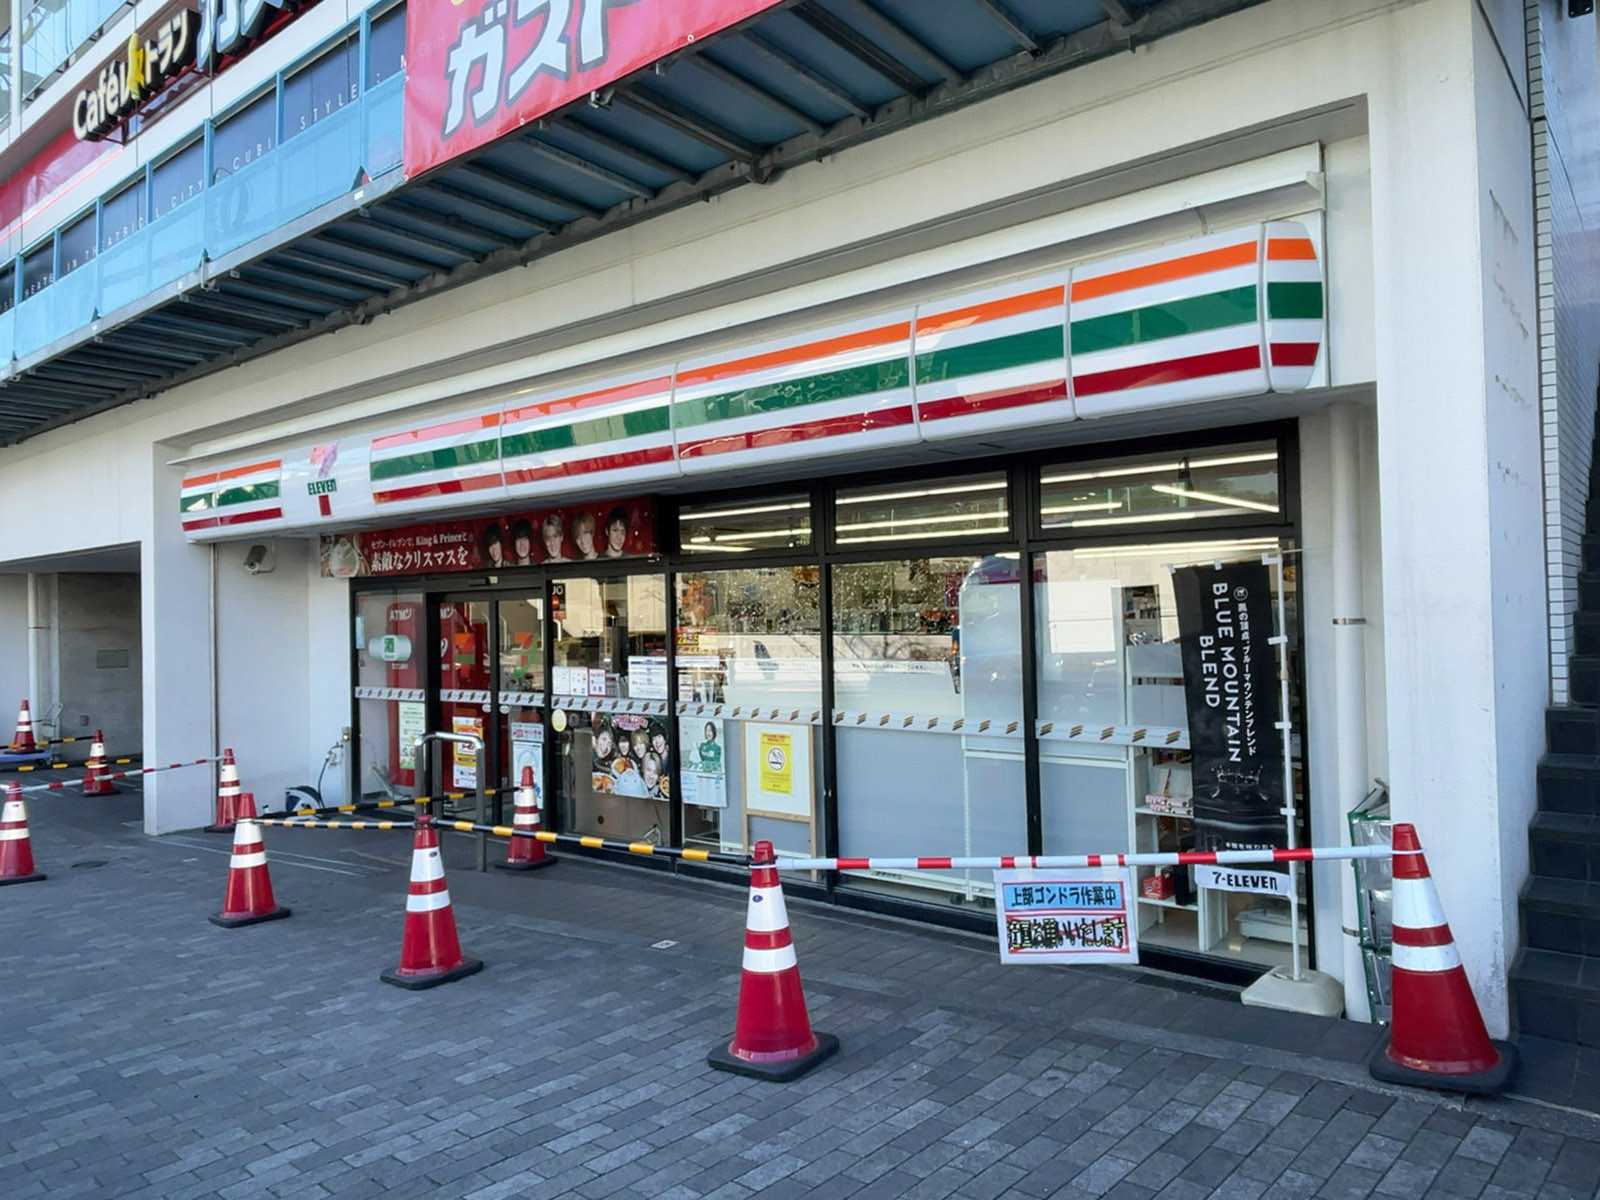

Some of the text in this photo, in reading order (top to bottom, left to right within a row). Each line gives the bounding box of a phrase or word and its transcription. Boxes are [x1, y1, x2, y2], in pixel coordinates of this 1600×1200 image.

[232, 137, 272, 170] CUBI
[300, 84, 358, 130] STYLE
[371, 546, 468, 571] 素敵なクリスマスを
[1199, 634, 1220, 709] BLEND
[1212, 582, 1242, 762] BLUE MOUNTAIN
[1012, 885, 1117, 907] 上部ゴンドラ作業中
